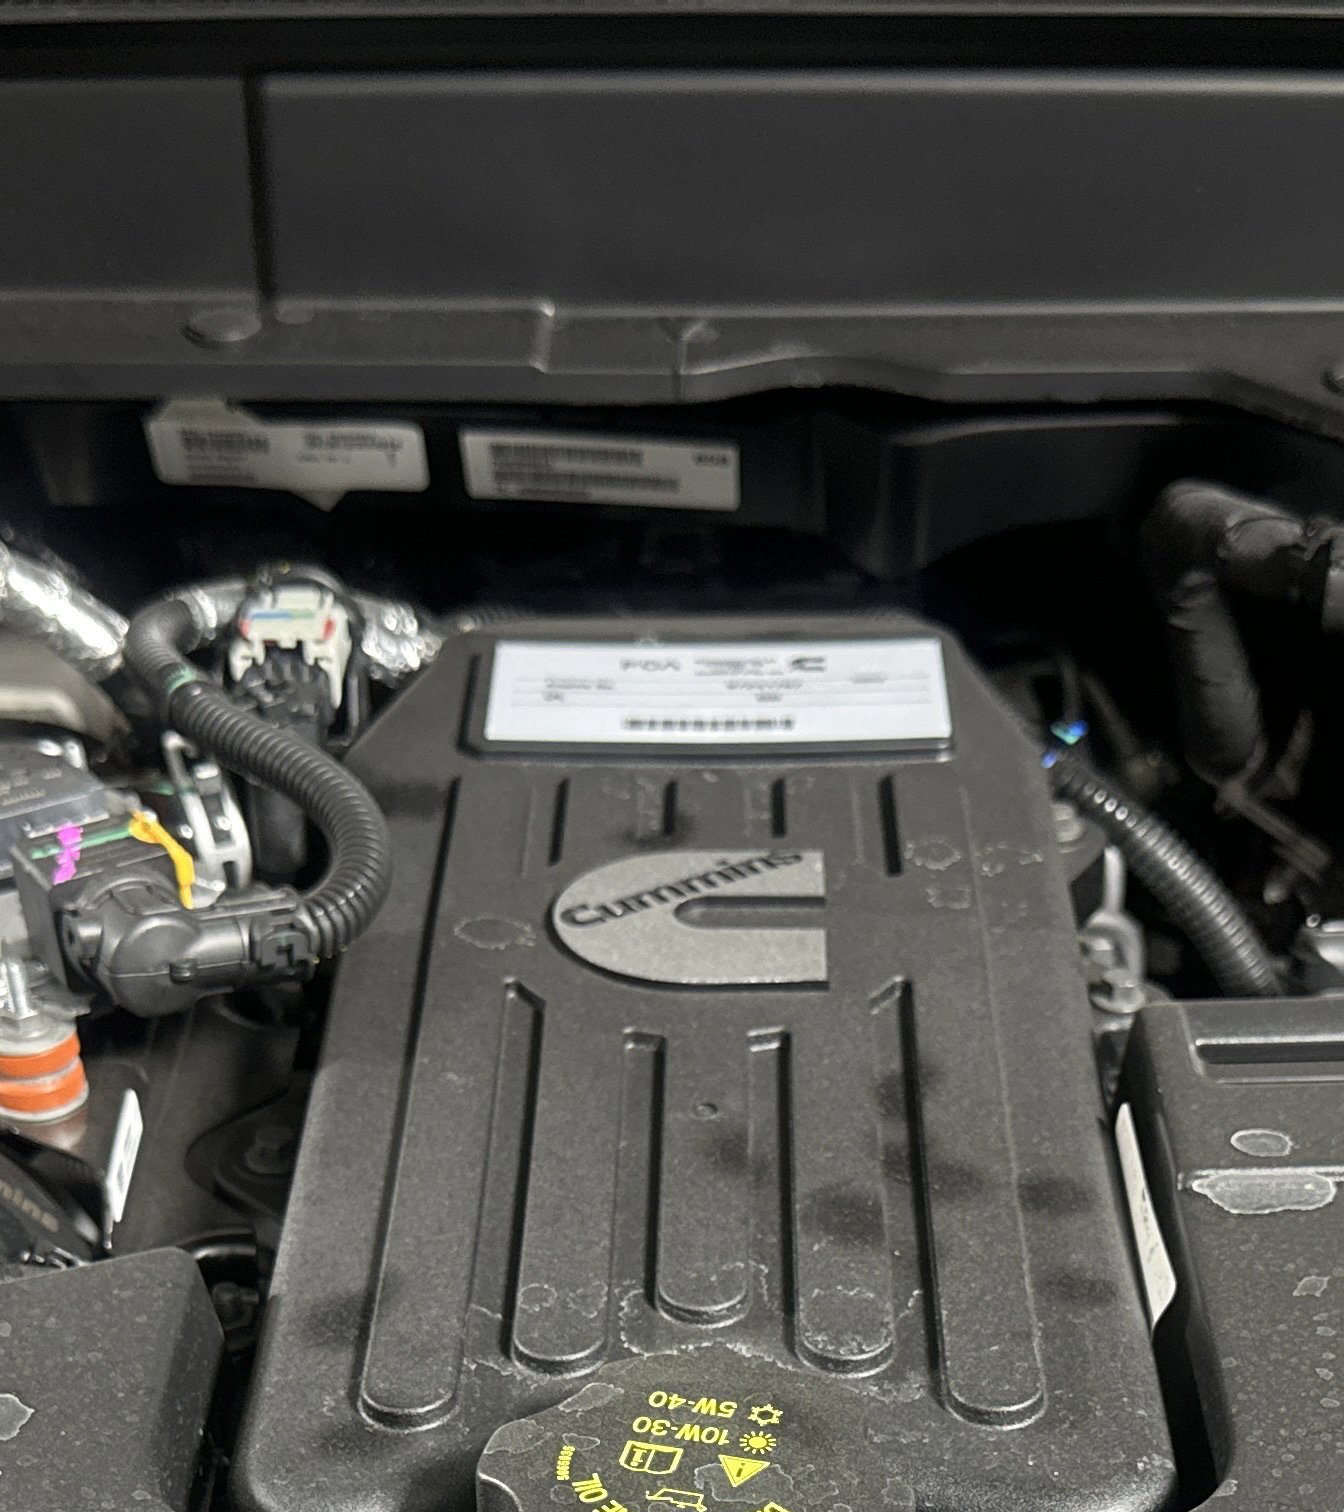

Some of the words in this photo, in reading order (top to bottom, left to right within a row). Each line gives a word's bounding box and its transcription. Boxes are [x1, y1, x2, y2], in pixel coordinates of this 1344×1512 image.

[559, 853, 803, 927] Cummins
[648, 1390, 738, 1418] 5W-40
[632, 1416, 730, 1446] 10W-30
[572, 1473, 608, 1503] OIL
